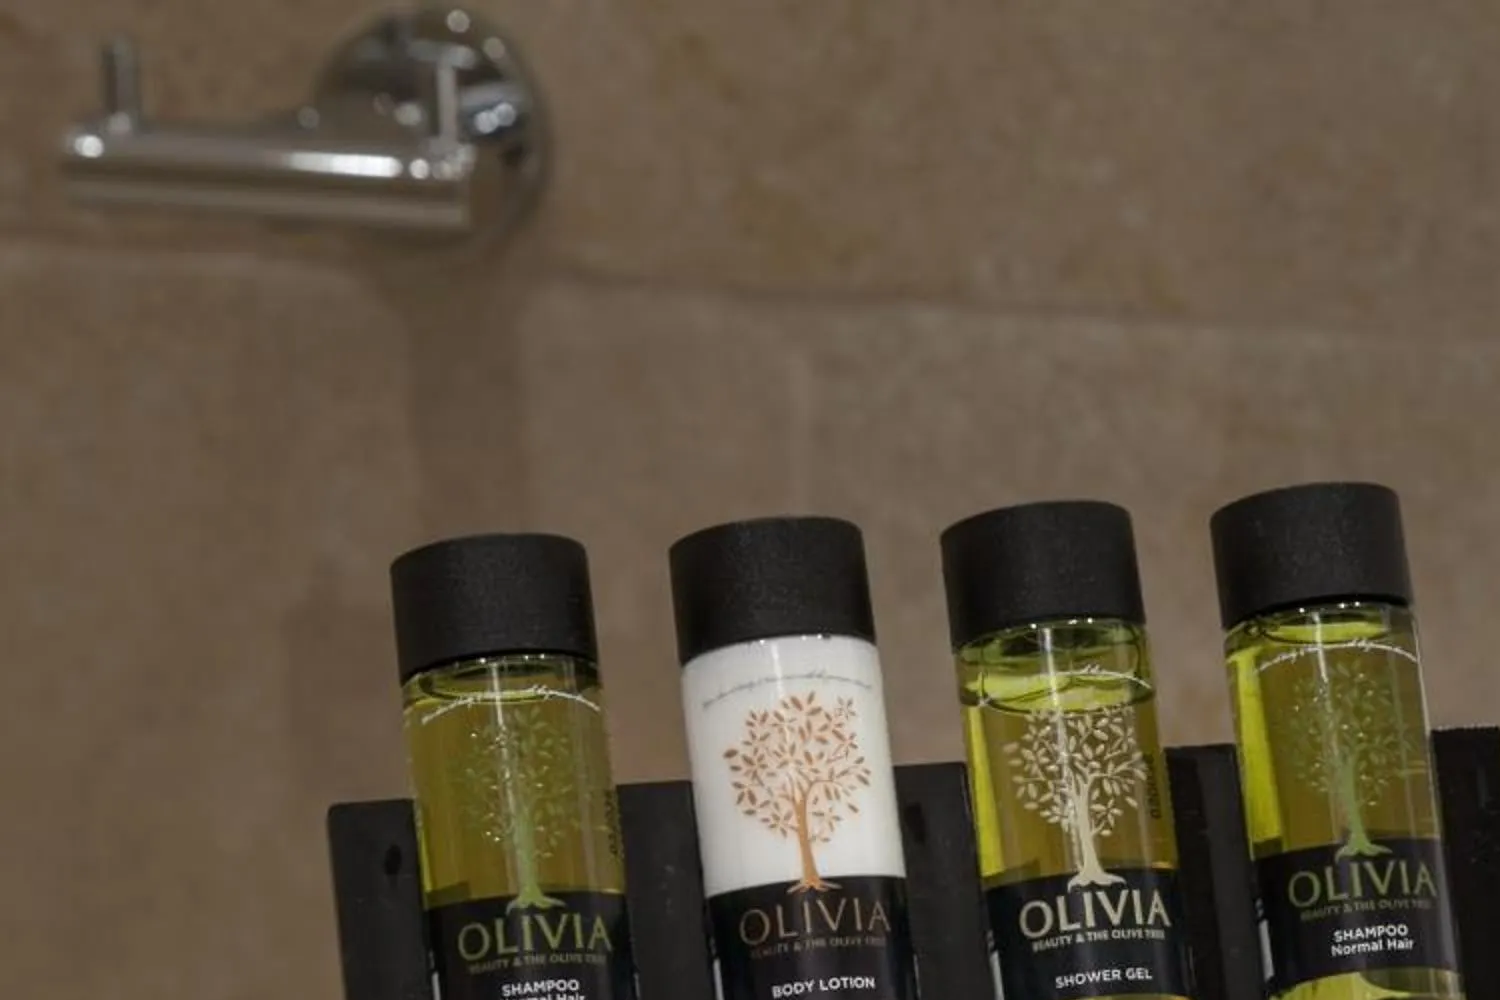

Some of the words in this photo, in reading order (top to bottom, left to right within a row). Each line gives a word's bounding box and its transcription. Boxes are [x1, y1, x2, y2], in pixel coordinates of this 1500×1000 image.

[1288, 859, 1438, 908] OLIVIA
[739, 898, 892, 945] OLIVIA
[1019, 888, 1172, 938] OLIVIA
[458, 912, 613, 961] OLIVIA
[1075, 932, 1085, 943] &
[1086, 929, 1109, 942] THE
[1111, 928, 1143, 940] OLIVE
[1333, 923, 1409, 943] SHAMPOO
[1331, 938, 1383, 957] Normal
[1387, 937, 1415, 951] Hair
[501, 979, 580, 997] SHAMPOO
[771, 979, 815, 999] BODY
[819, 975, 876, 992] LOTION
[1055, 968, 1122, 989] SHOWER
[1125, 966, 1153, 981] GEL
